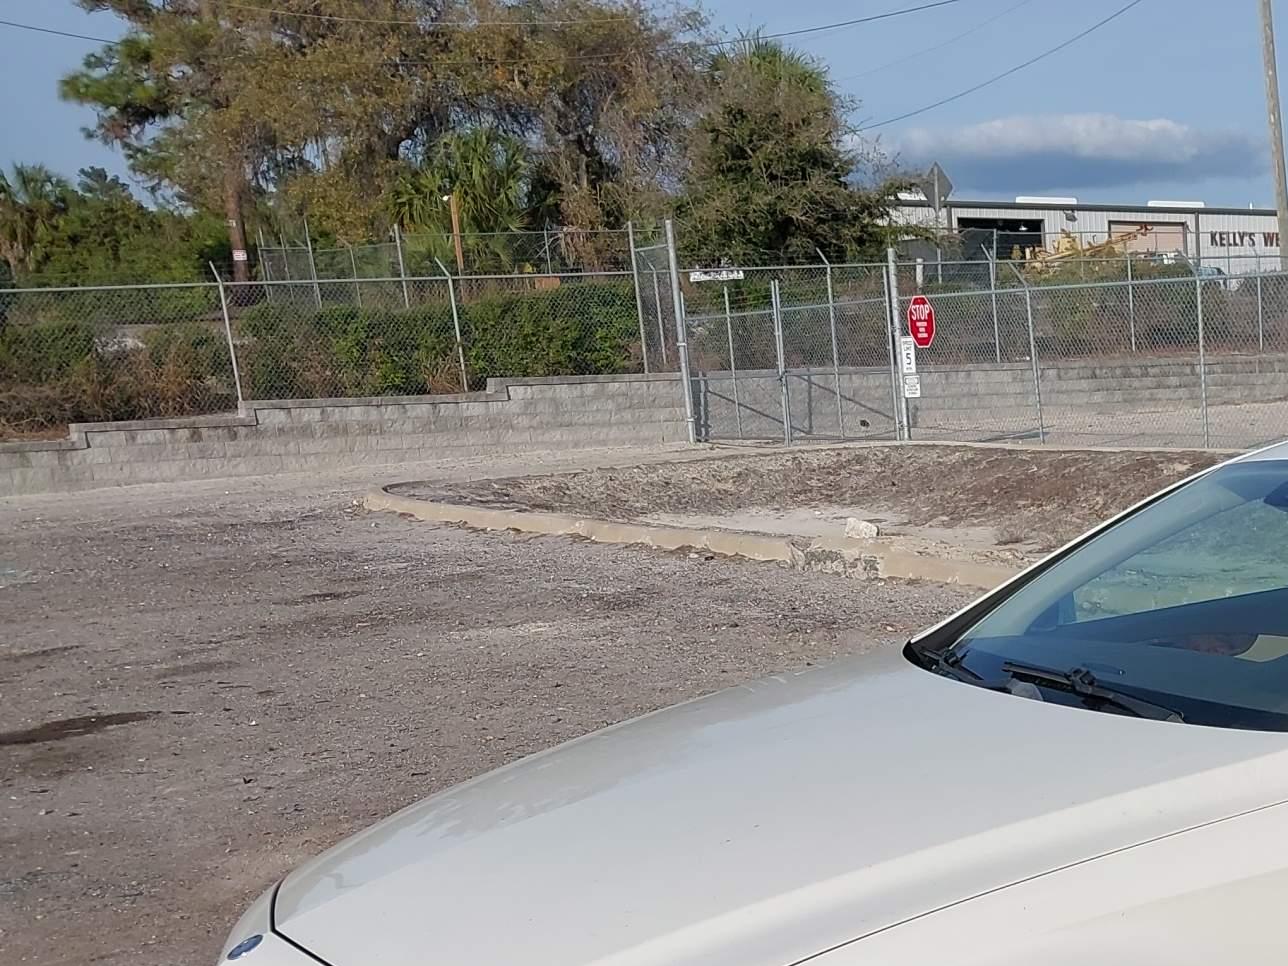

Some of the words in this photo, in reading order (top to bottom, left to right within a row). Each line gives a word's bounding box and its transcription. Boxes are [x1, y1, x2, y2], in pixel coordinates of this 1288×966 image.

[1210, 231, 1256, 247] KELLY'S
[911, 304, 930, 321] STOP
[905, 353, 912, 365] 5
